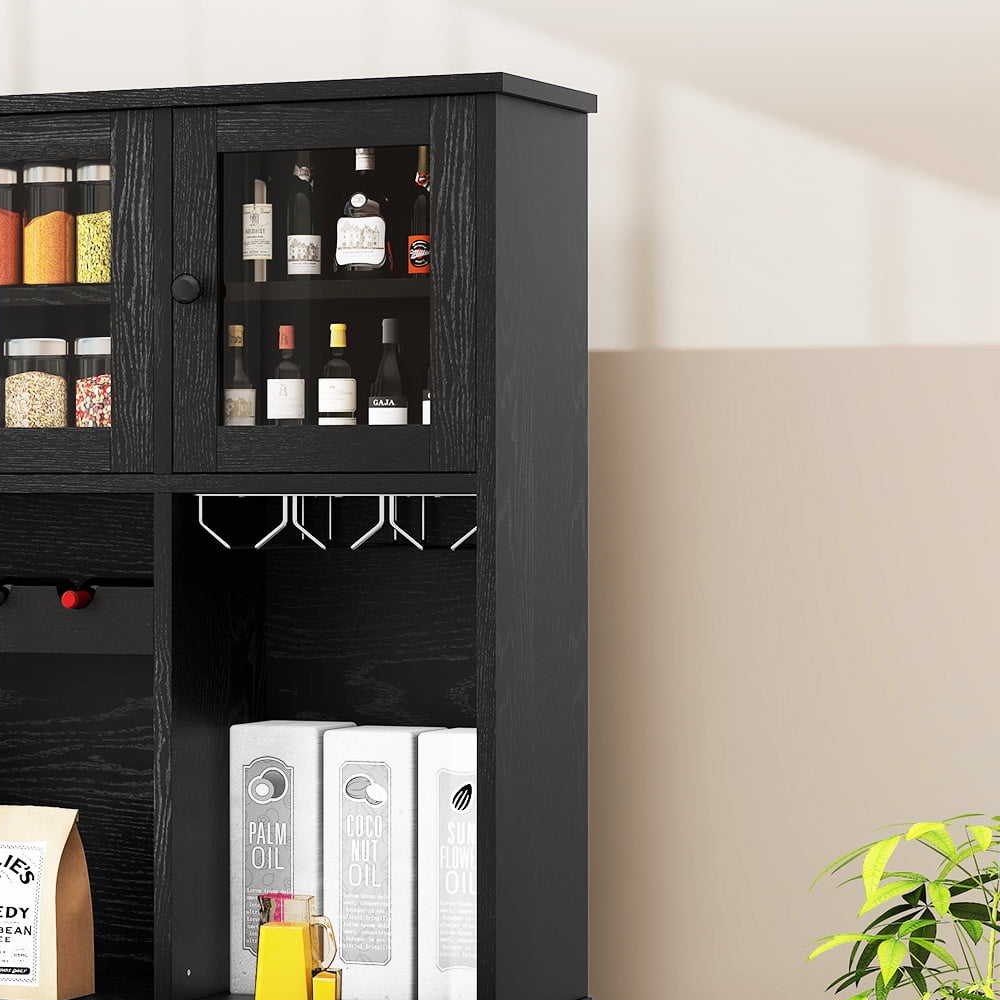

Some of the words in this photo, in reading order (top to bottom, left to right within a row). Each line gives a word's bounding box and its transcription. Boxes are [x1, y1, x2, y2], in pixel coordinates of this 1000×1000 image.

[249, 821, 287, 845] PALM
[346, 814, 382, 837] COCO
[447, 821, 477, 845] SUN
[251, 846, 285, 870] OIL
[351, 839, 378, 862] NUT
[348, 863, 381, 887] OIL
[445, 870, 477, 895] OIL
